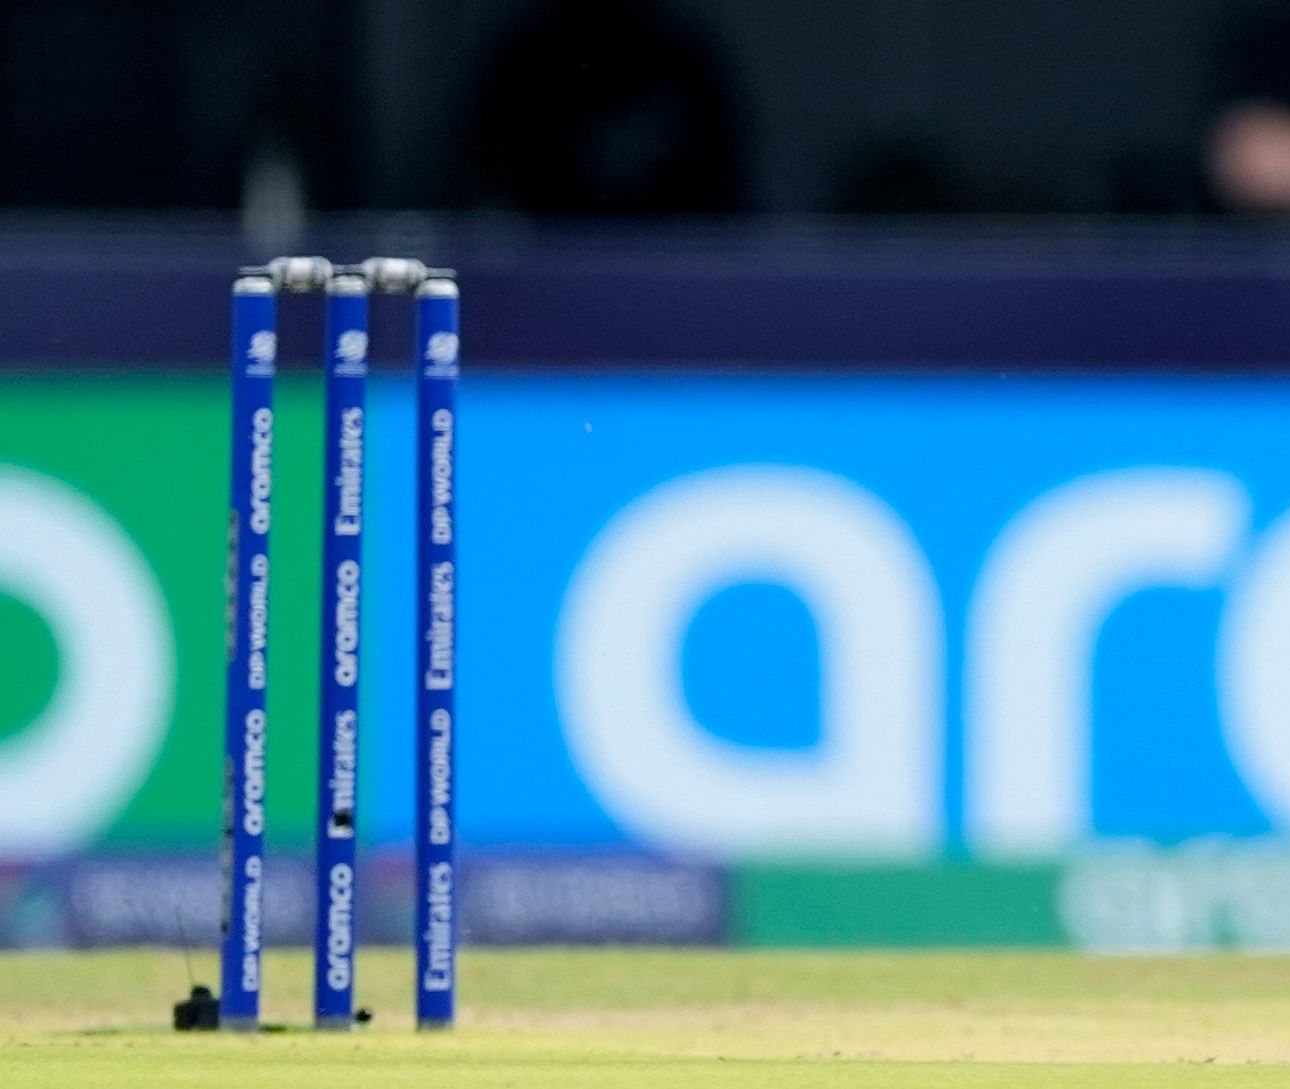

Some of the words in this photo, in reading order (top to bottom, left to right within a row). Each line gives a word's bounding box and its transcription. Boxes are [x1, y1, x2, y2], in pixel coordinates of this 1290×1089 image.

[250, 407, 273, 535] aramco
[334, 406, 363, 536] Emirates
[431, 408, 453, 505] WORLD
[431, 506, 453, 545] DP
[249, 554, 269, 650] WORLD
[335, 559, 361, 687] aramco
[425, 561, 454, 690] Emirates
[248, 651, 266, 690] DP
[244, 709, 266, 836] aramco
[430, 708, 451, 805] WORLD
[429, 806, 450, 845] DP
[244, 856, 263, 952] WORLD
[327, 863, 353, 991] aramco
[423, 861, 452, 992] Emirates
[242, 953, 260, 992] DP
